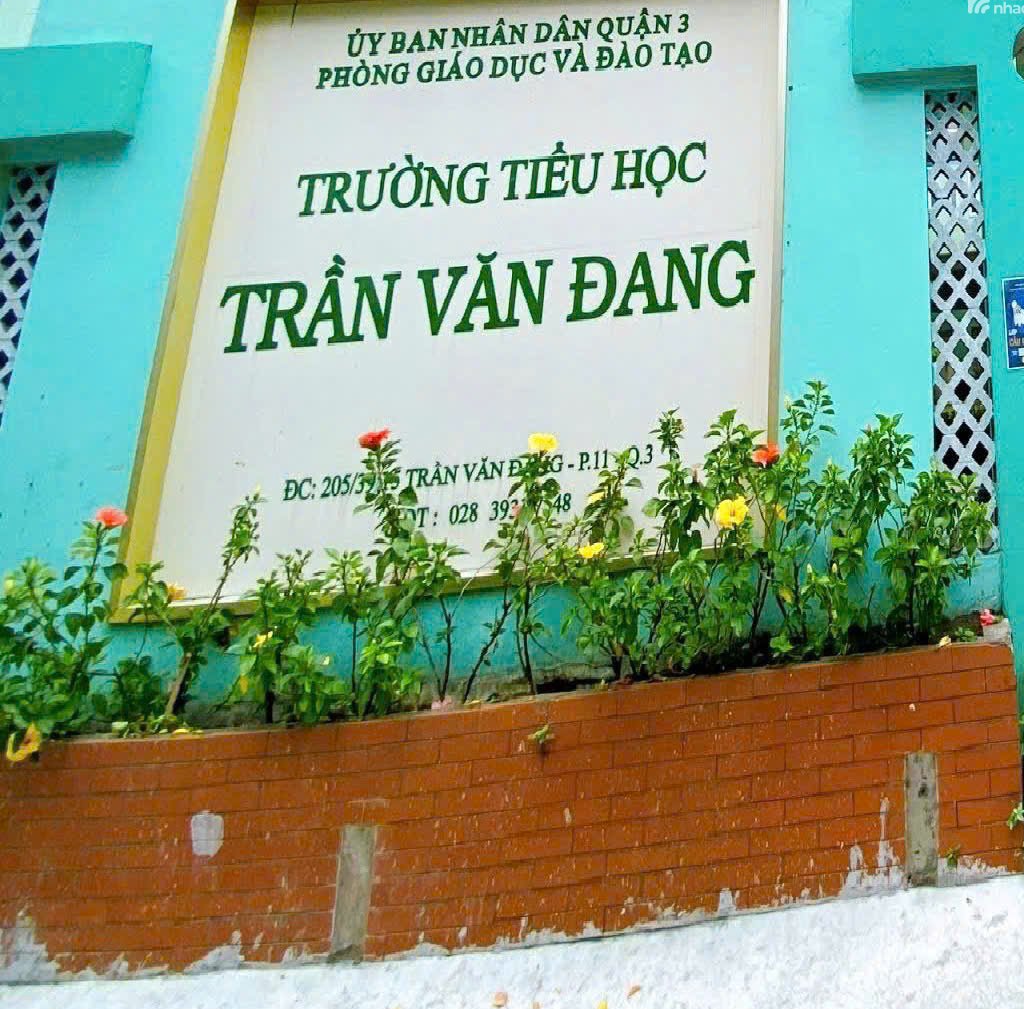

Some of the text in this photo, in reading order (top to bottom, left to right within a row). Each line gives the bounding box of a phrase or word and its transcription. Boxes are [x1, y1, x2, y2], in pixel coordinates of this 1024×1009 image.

[347, 7, 690, 57] ỦY BAN NHÂN DÂN QUẬN 3
[315, 40, 713, 89] PHÒNG GIÁO DỤC VÀ ĐÀO TẠO
[297, 141, 707, 217] TRƯỜNG TIỂU HỌC
[219, 239, 756, 353] TRẦN VĂN ĐANG
[282, 478, 316, 501] ĐC:
[405, 461, 459, 488] TRẦN
[463, 456, 505, 482] VĂN
[507, 454, 563, 478] ĐG
[627, 443, 654, 470] Q.3
[449, 502, 479, 525] 028
